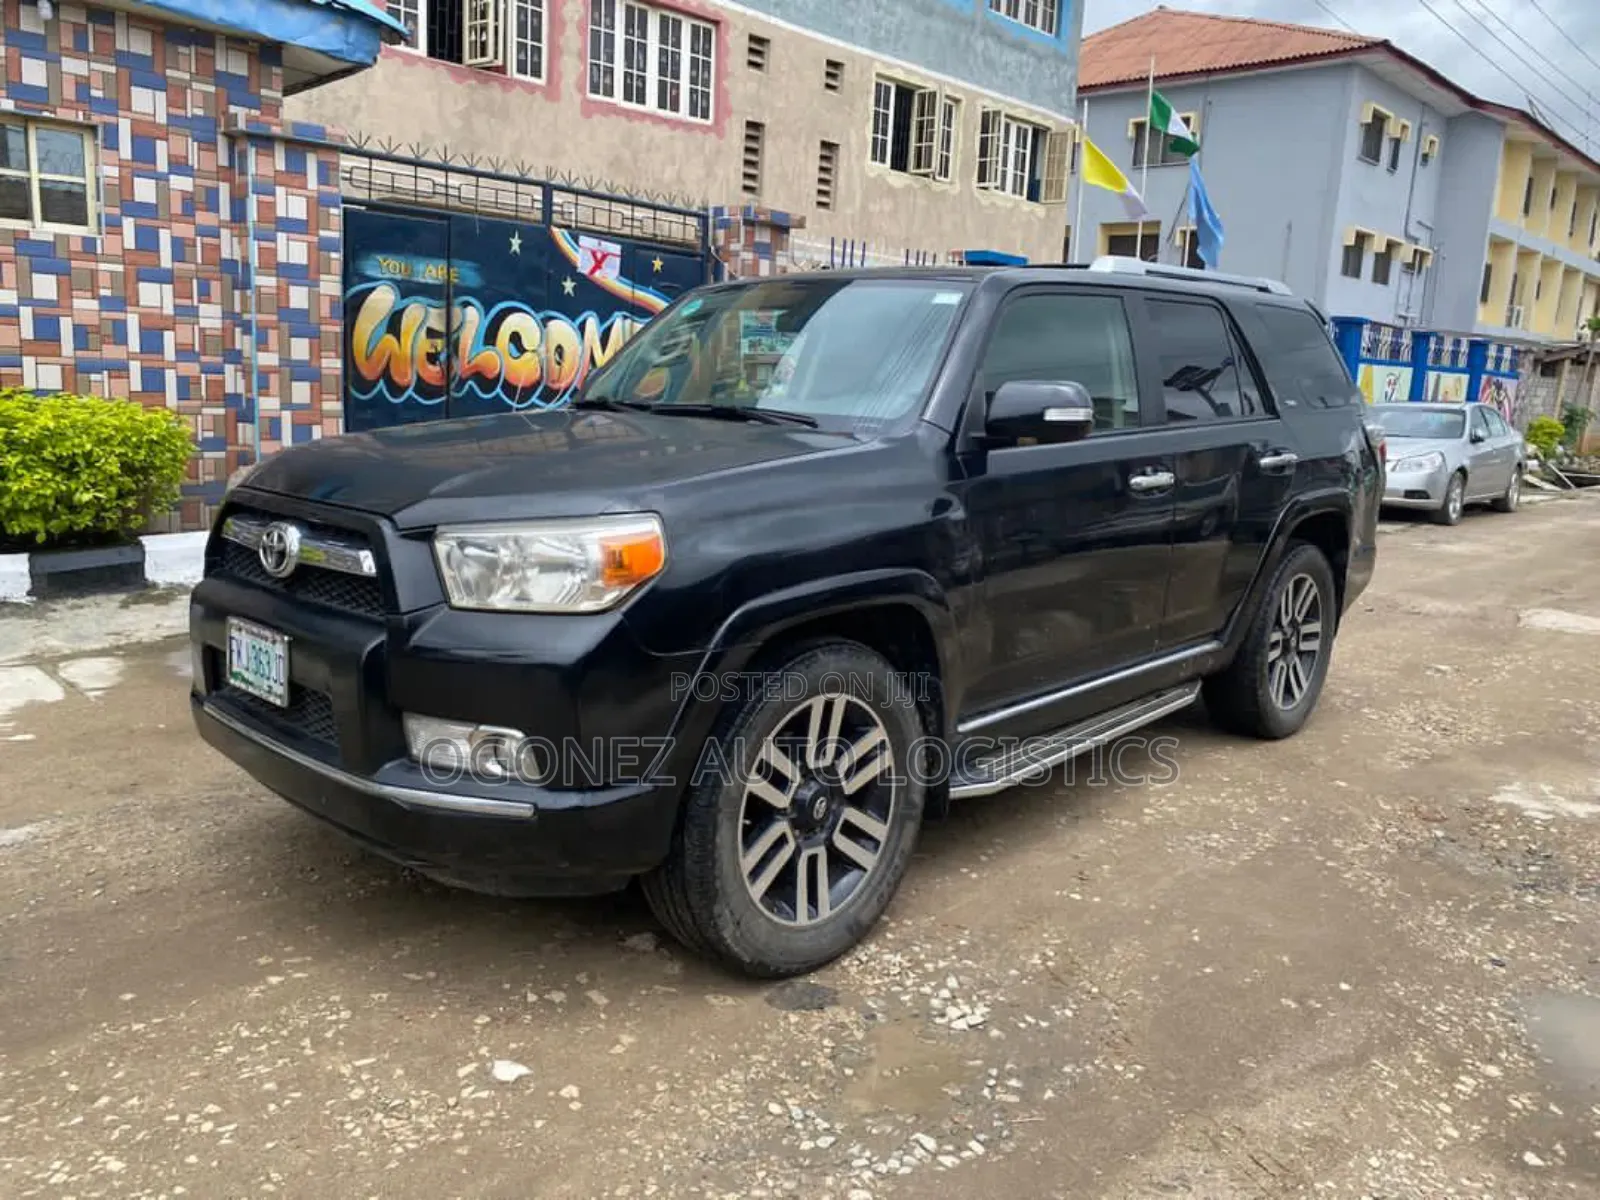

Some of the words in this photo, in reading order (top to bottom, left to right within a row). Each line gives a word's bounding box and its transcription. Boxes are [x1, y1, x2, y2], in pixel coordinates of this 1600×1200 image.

[379, 257, 412, 276] YOU
[425, 262, 460, 284] ARE
[353, 284, 645, 391] WELCOM
